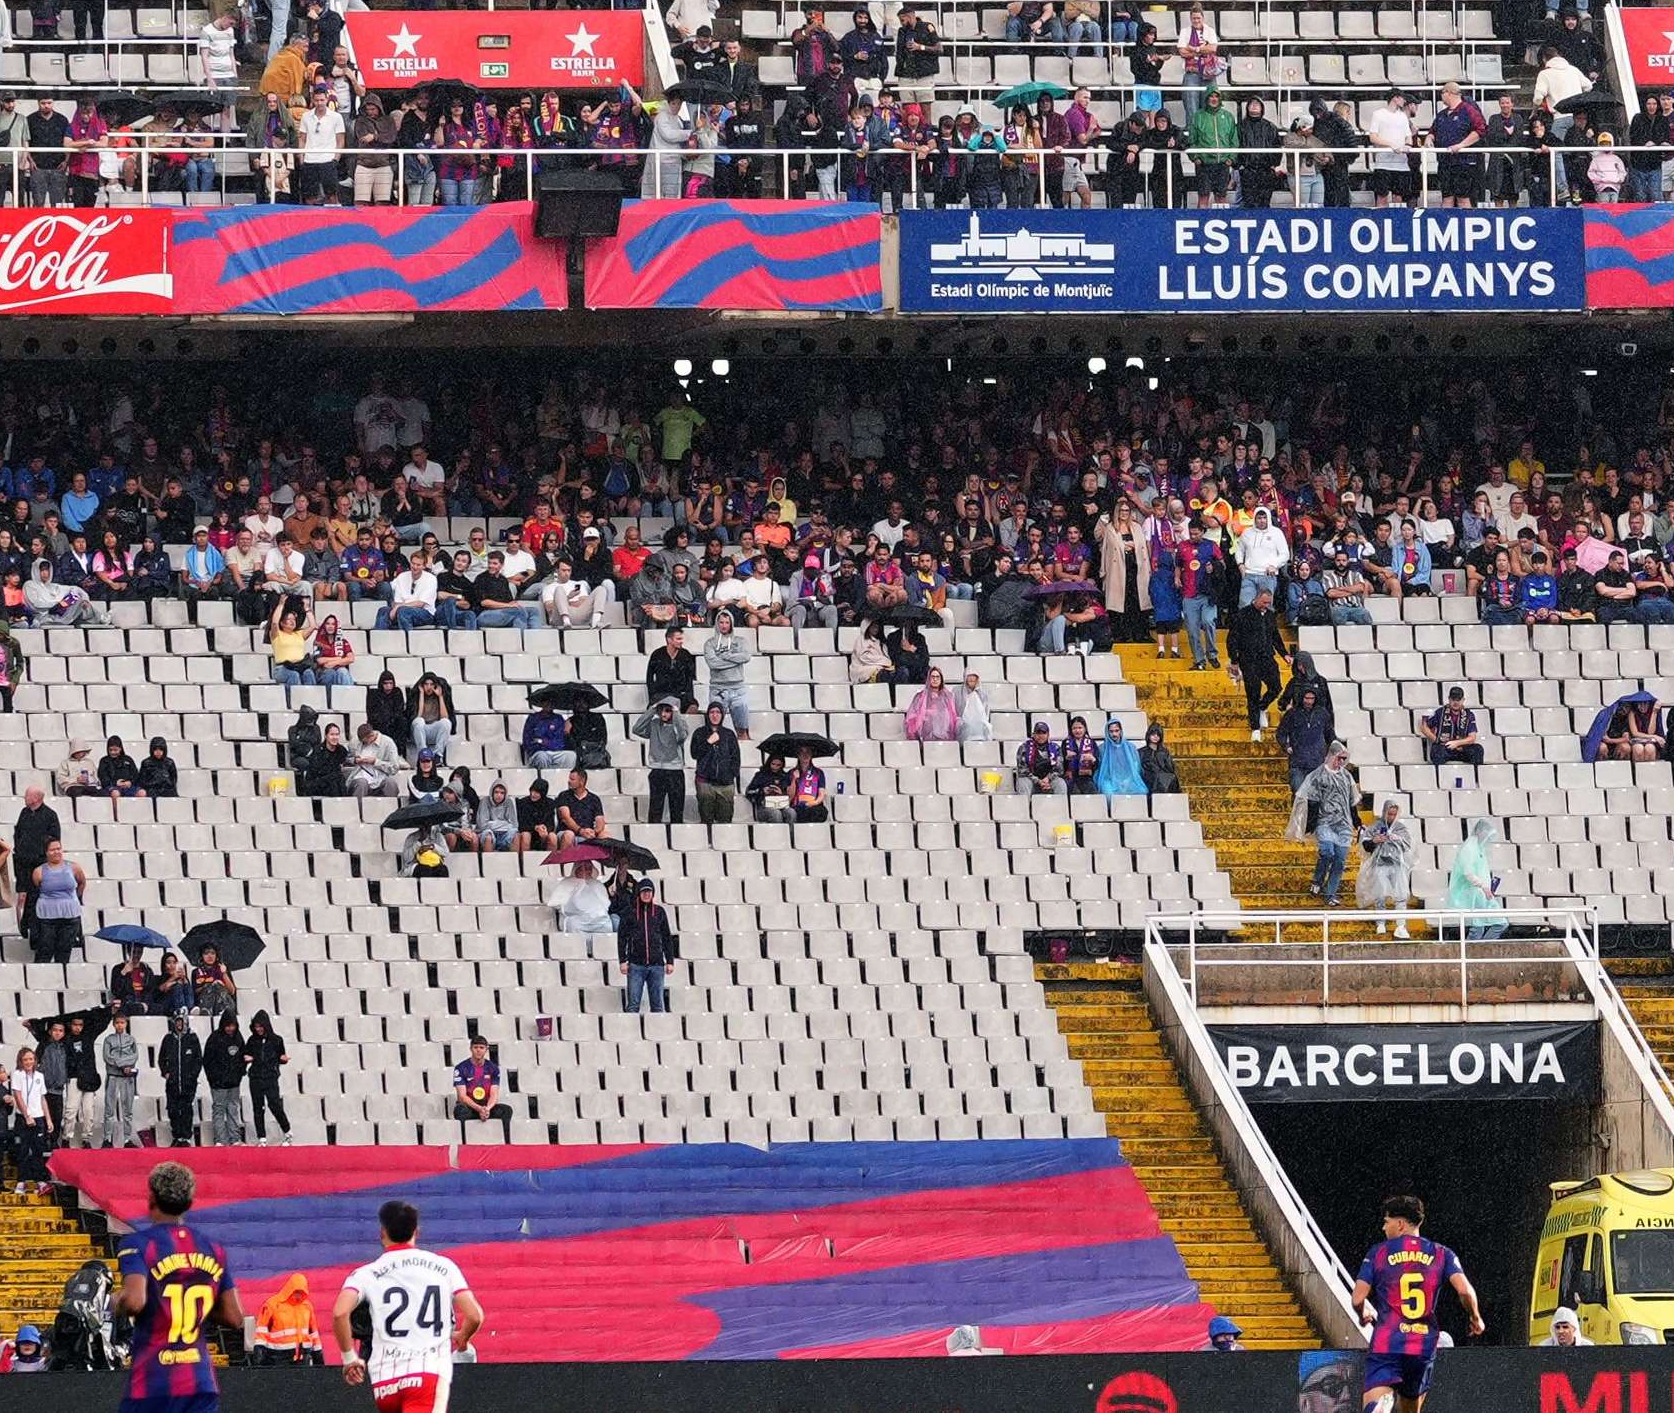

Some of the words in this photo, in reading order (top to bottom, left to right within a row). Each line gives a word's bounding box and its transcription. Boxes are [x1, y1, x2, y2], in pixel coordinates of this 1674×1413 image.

[372, 57, 438, 71] ESTRELLA
[550, 57, 615, 70] ESTRELLA
[1175, 218, 1332, 255] ESTADI
[1350, 209, 1538, 254] OLÍMPIC
[931, 285, 973, 299] Estadi
[977, 283, 1029, 301] Olímpic
[1033, 284, 1050, 298] de
[1054, 283, 1113, 301] Montjuïc
[1159, 256, 1289, 301] LLUÍS
[1302, 261, 1556, 300] COMPANYS
[1226, 1042, 1567, 1089] BARCELONA
[401, 1256, 449, 1277] MORENO
[162, 1283, 215, 1345] 10
[382, 1284, 444, 1338] 24
[1399, 1272, 1427, 1320] 5
